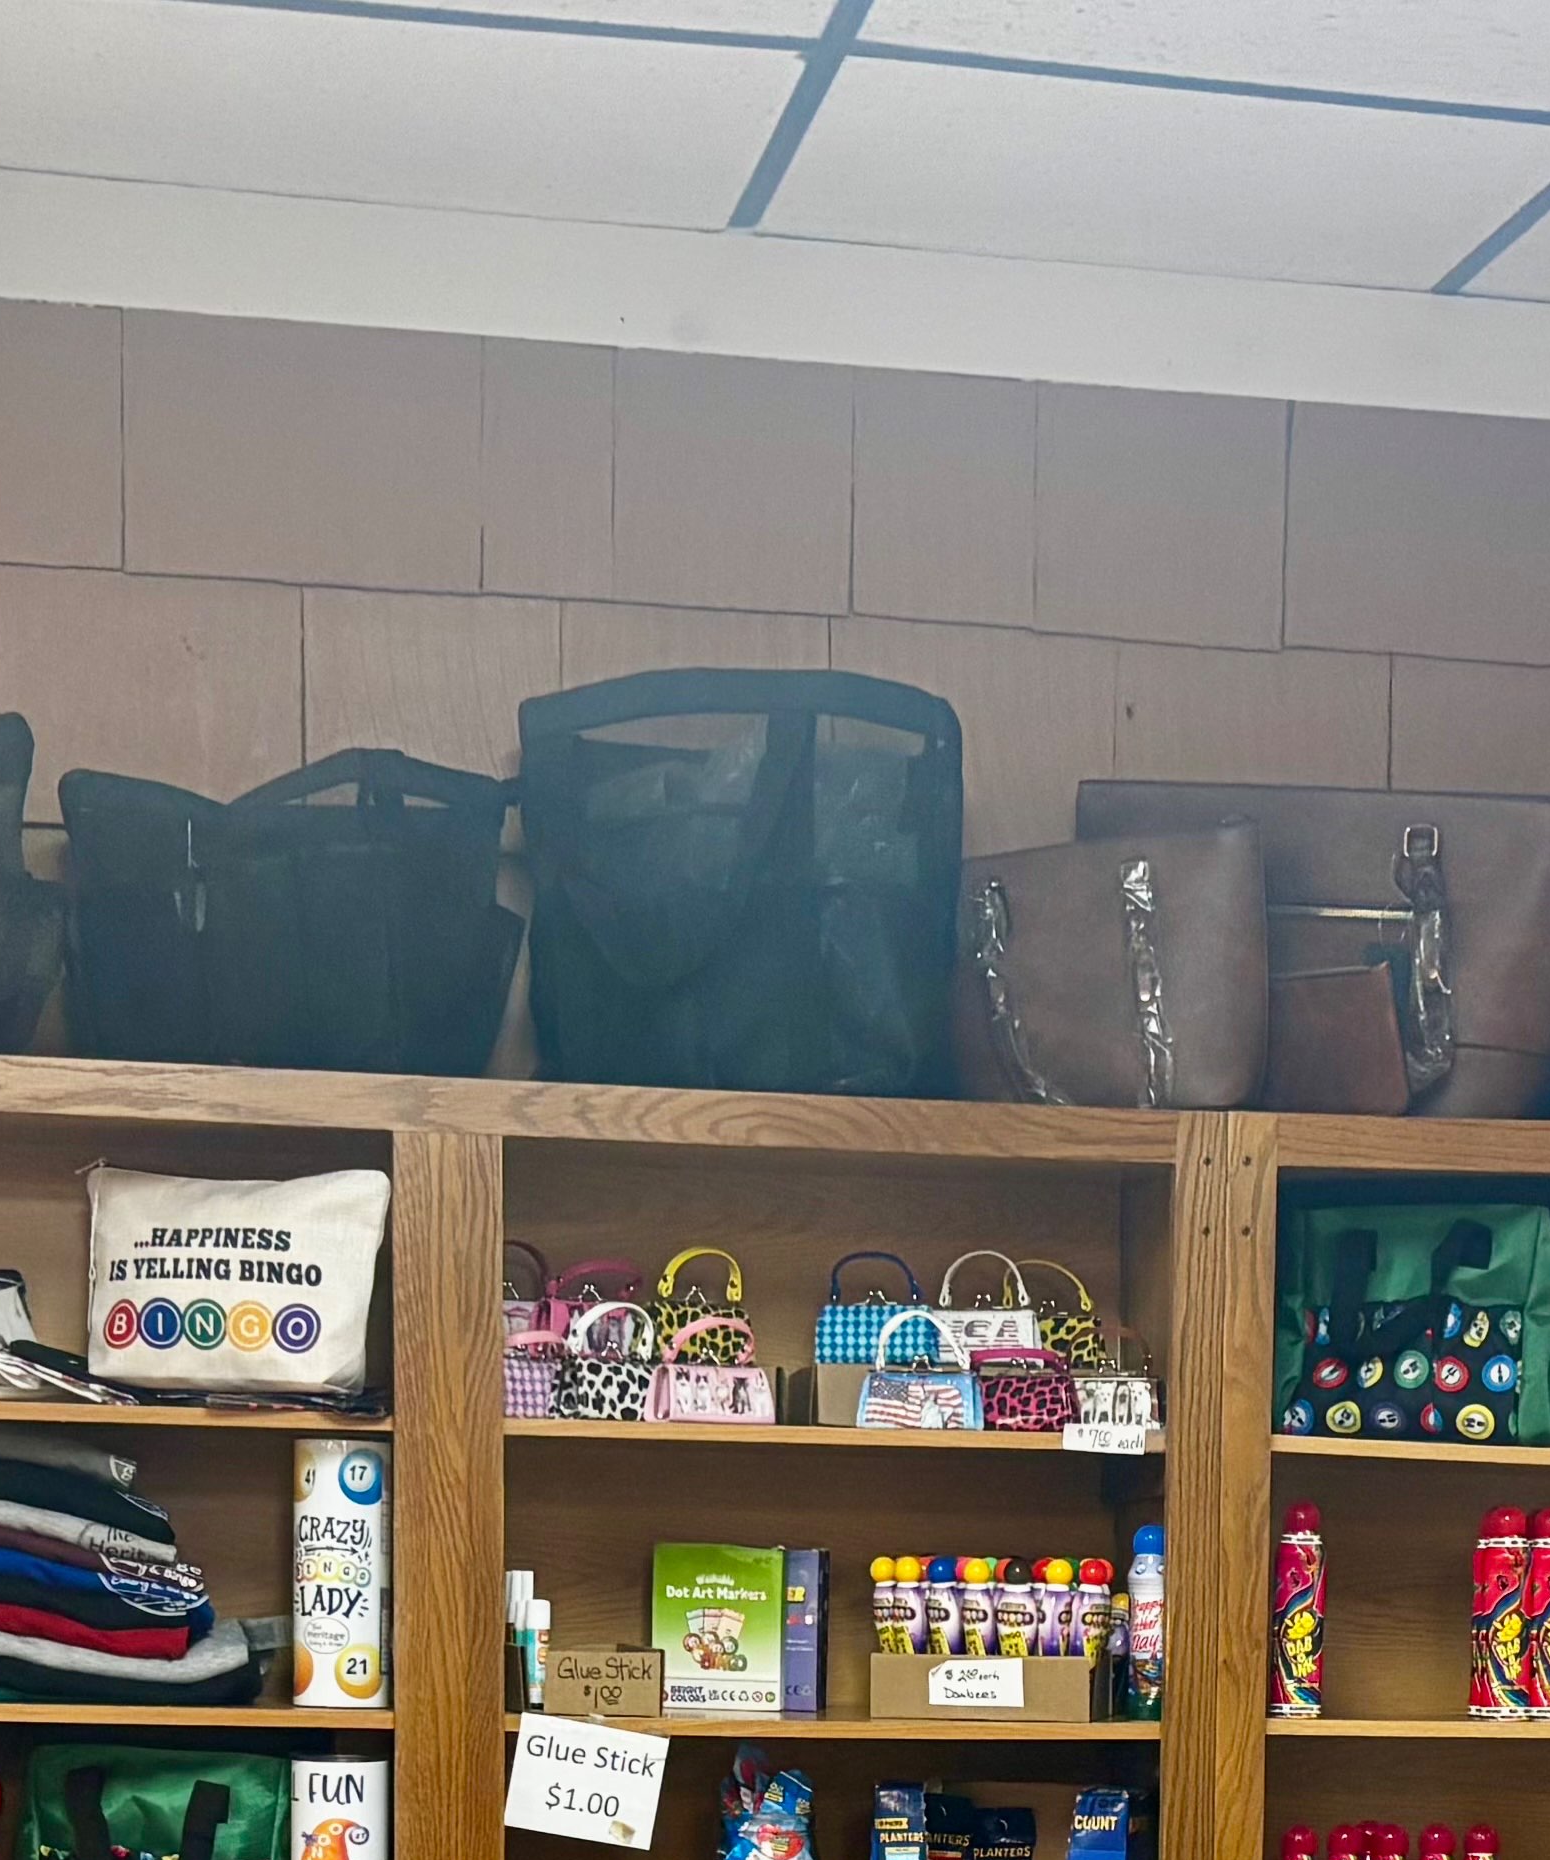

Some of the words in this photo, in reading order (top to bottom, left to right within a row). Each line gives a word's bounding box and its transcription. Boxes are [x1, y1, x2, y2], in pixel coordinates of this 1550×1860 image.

[109, 1259, 127, 1281] IS
[133, 1257, 231, 1280] YELLING
[239, 1259, 322, 1287] BINGO
[349, 1465, 368, 1481] 17
[299, 1514, 366, 1545] CRAZY
[299, 1584, 363, 1619] LADY
[665, 1585, 689, 1599] Dot
[692, 1586, 714, 1600] Art
[716, 1587, 767, 1601] Markers
[1286, 1636, 1313, 1656] DAB
[346, 1657, 368, 1676] 21
[557, 1656, 601, 1680] Glue
[605, 1656, 652, 1682] Stick
[526, 1734, 587, 1765] Glue
[594, 1746, 656, 1778] Stick
[309, 1772, 364, 1806] FUN
[545, 1782, 620, 1818] $1.00
[1074, 1815, 1118, 1831] COUNT
[880, 1833, 924, 1843] PLANTERS
[974, 1846, 1031, 1858] PLANTERS
